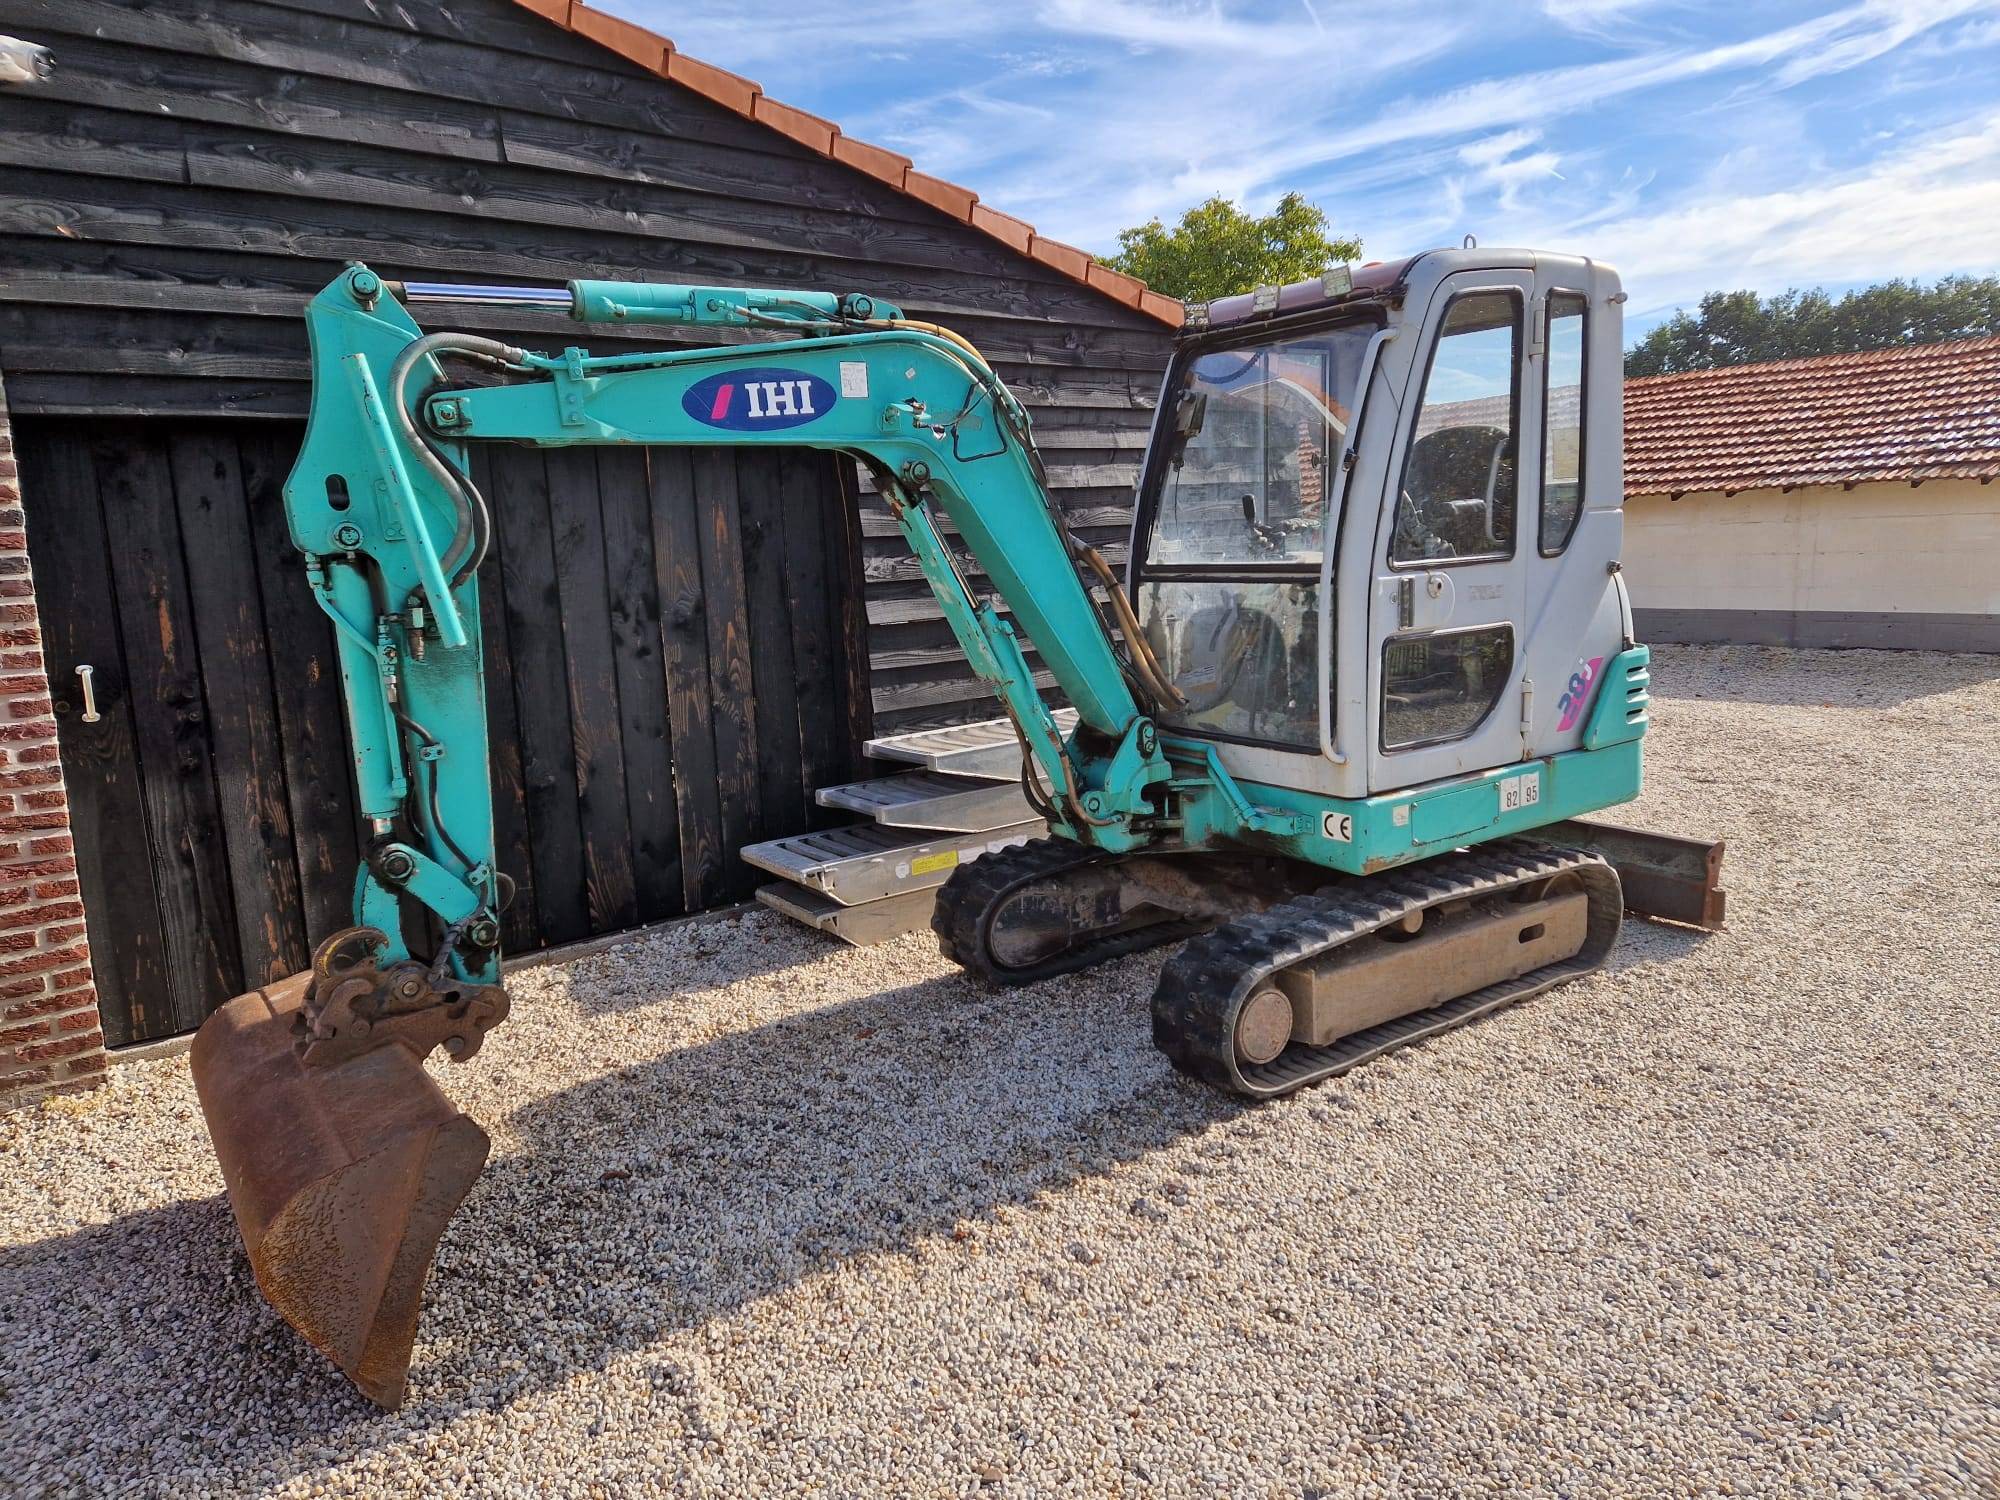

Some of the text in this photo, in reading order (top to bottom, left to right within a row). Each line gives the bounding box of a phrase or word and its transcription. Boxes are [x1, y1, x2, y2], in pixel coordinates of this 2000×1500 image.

[744, 380, 814, 418] IHI
[1506, 790, 1518, 808] 82
[1526, 785, 1538, 803] 95
[1324, 813, 1350, 841] CE
